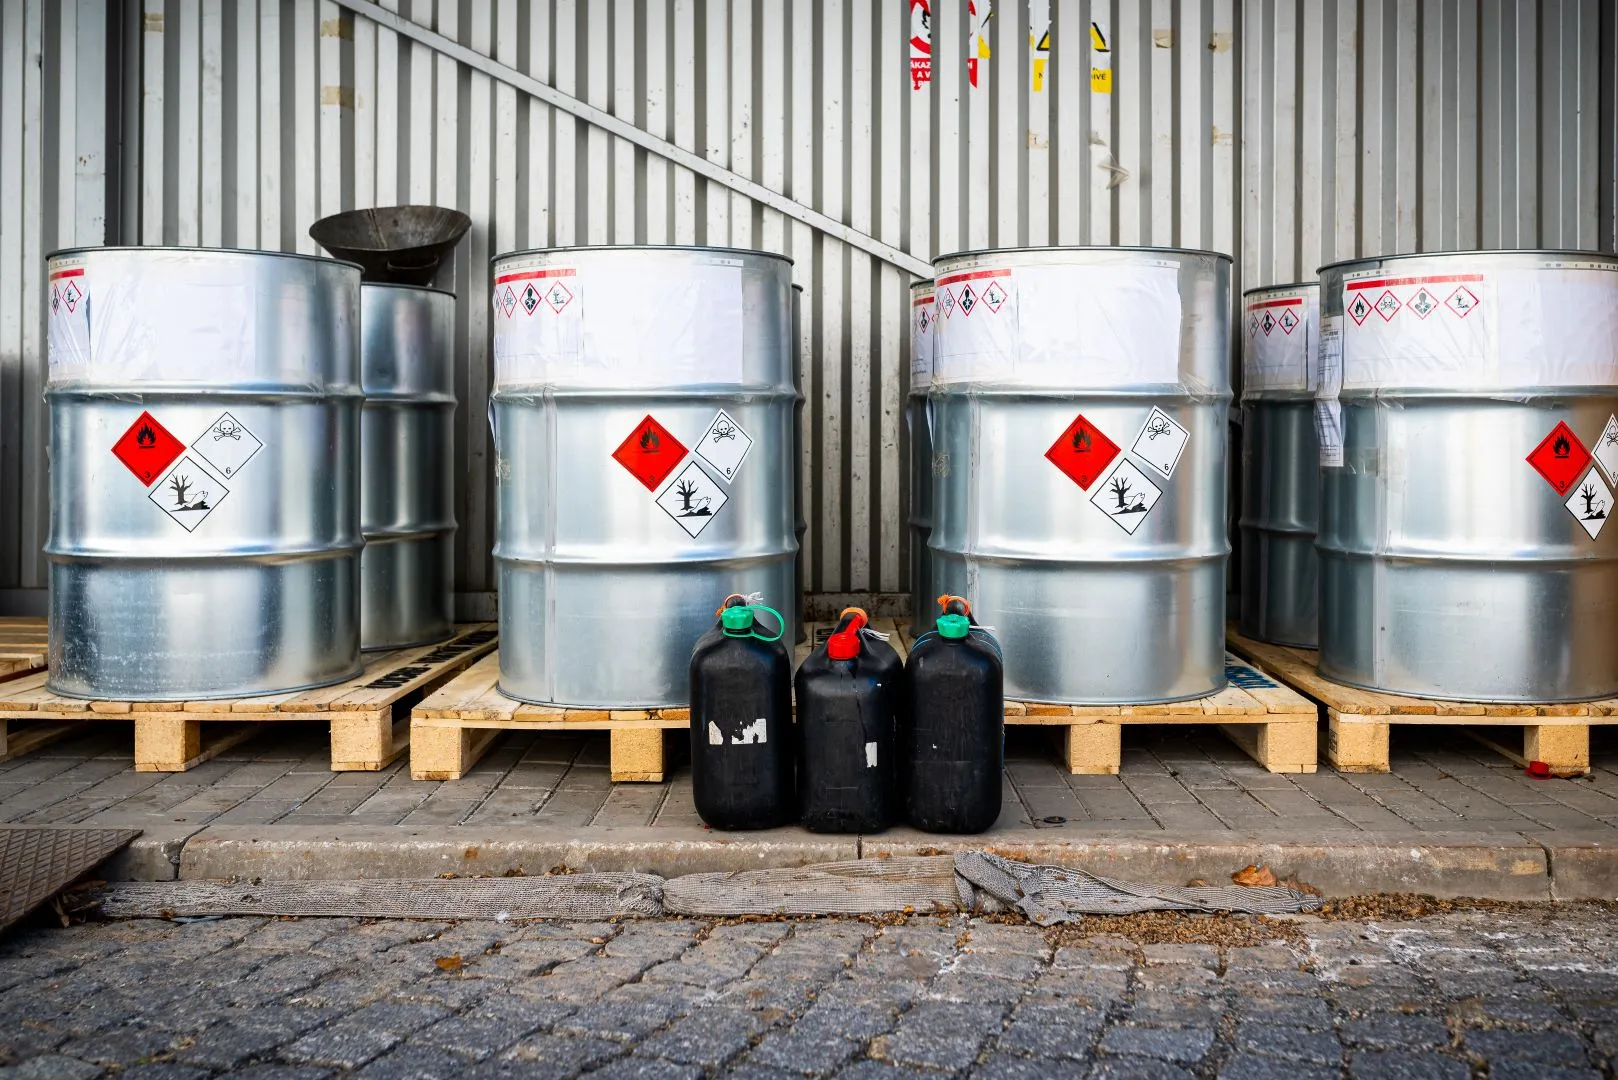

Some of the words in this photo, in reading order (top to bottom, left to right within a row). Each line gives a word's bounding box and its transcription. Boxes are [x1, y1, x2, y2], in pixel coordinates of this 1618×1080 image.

[226, 466, 231, 475] 6
[727, 467, 731, 475] 6
[1164, 463, 1169, 471] 6
[145, 471, 151, 479] 3
[1559, 480, 1565, 488] 3
